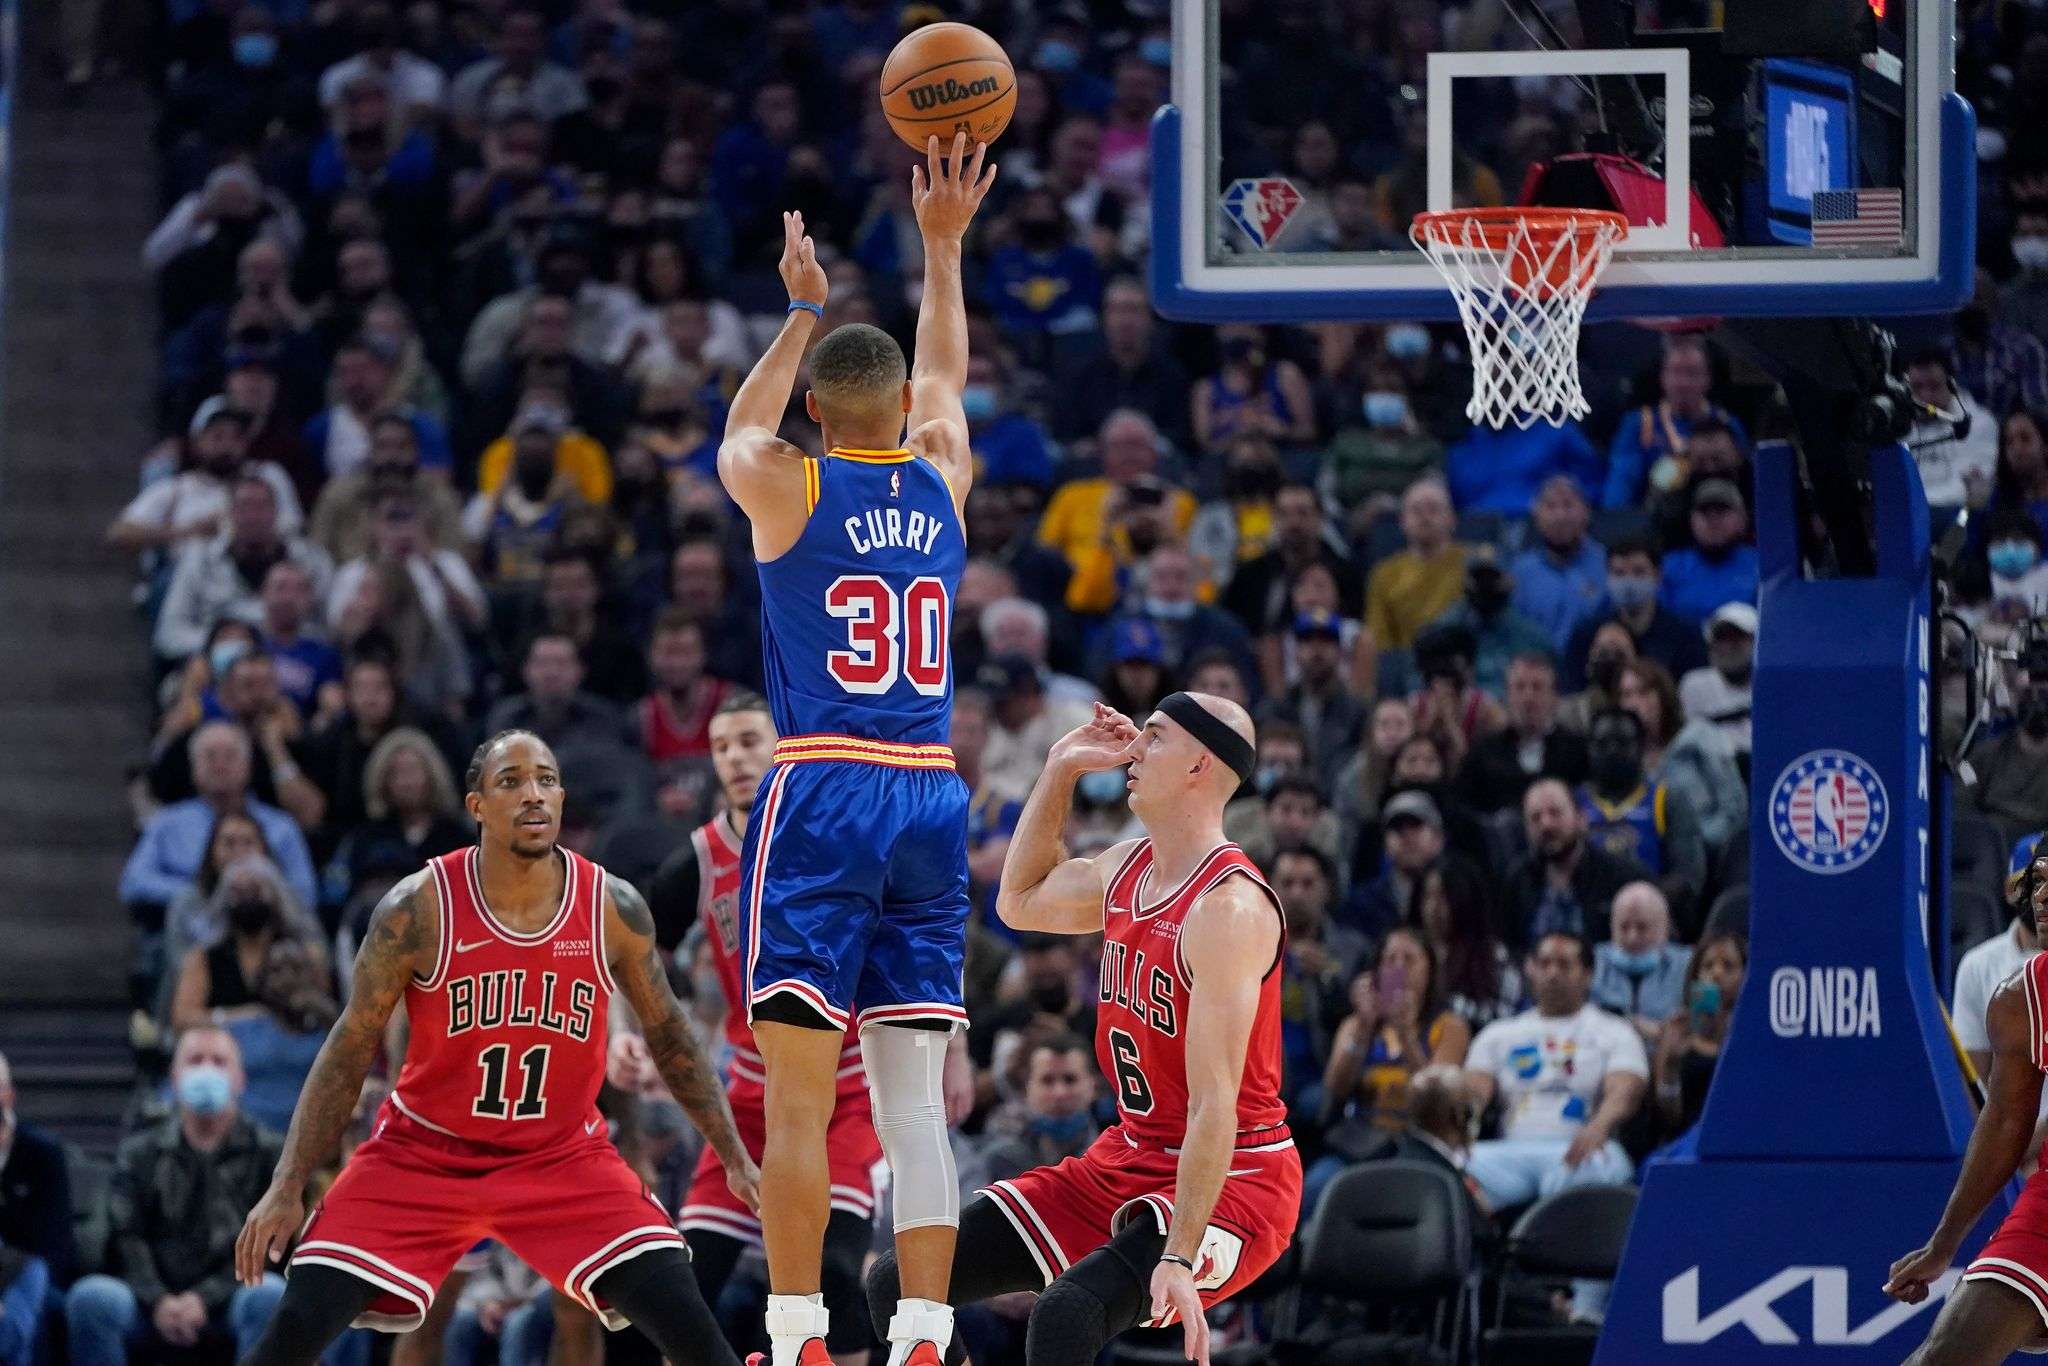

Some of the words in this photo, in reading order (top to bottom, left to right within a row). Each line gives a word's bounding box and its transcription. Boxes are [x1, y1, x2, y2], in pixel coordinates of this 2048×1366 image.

[907, 75, 999, 112] Wilson
[844, 508, 943, 555] CURRY
[825, 575, 950, 697] 30
[447, 969, 596, 1043] BULLS
[1100, 940, 1178, 1038] ULLS
[1769, 965, 1882, 1038] @NBA
[471, 1042, 551, 1121] 11
[1108, 1026, 1155, 1117] 6
